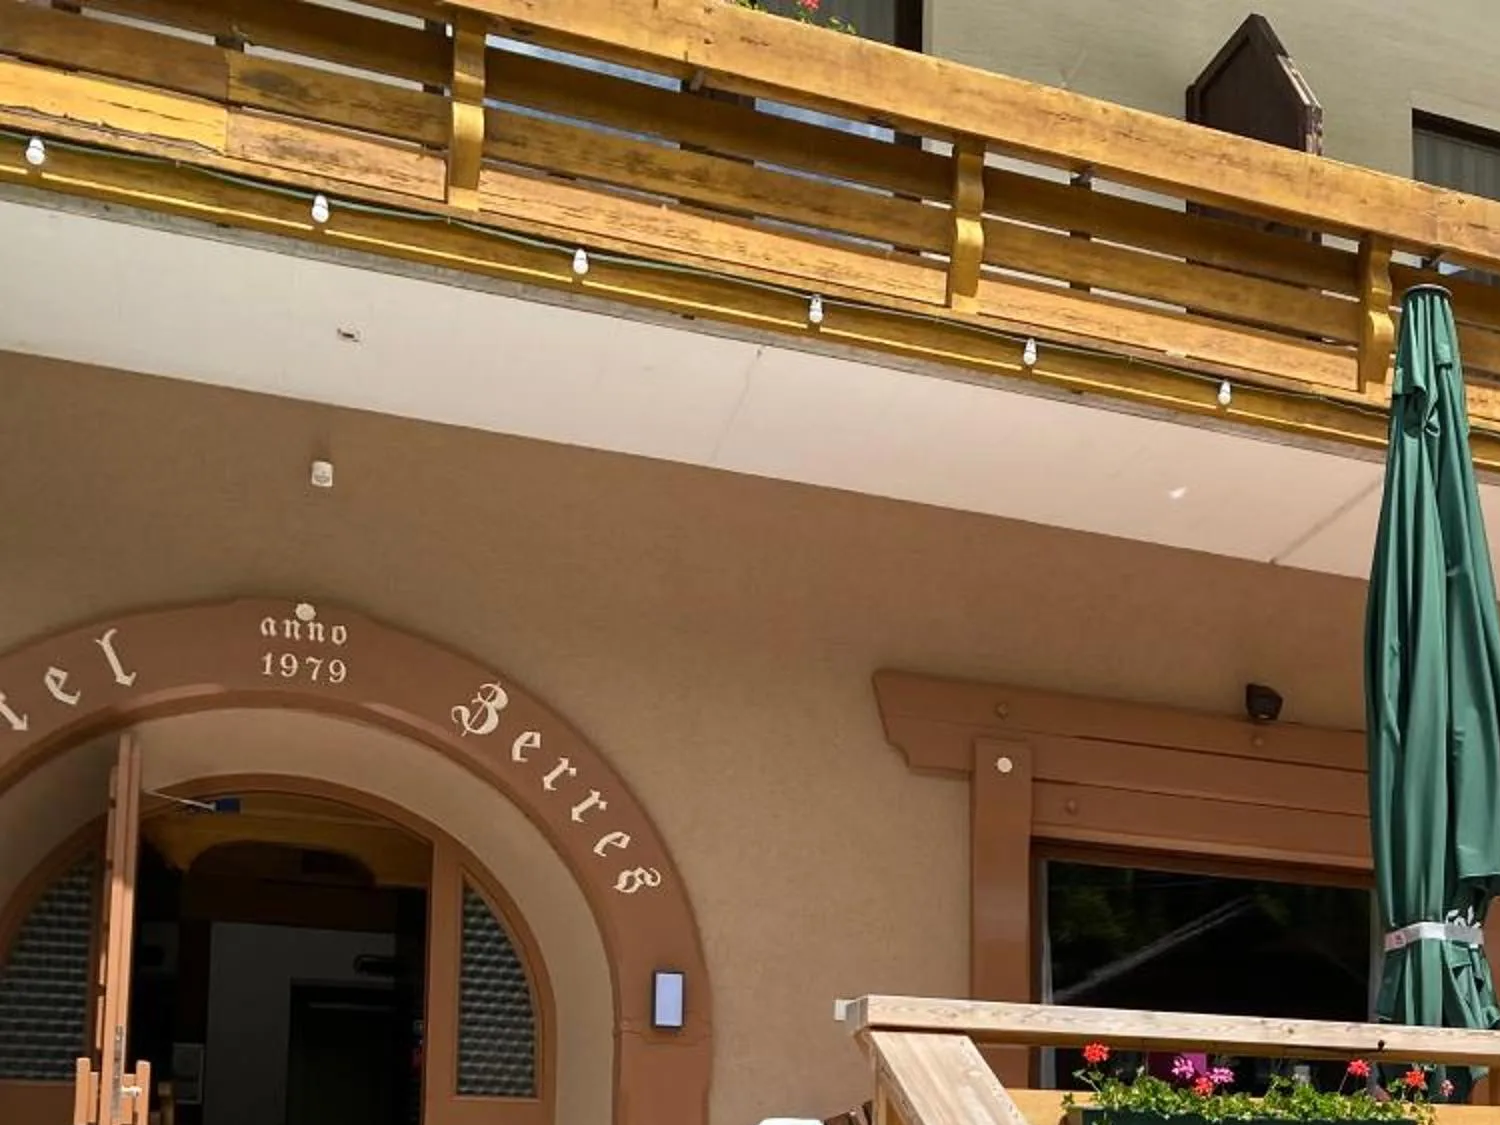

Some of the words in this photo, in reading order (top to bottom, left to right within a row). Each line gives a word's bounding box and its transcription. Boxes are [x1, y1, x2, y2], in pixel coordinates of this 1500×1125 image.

[260, 616, 347, 645] anno
[261, 652, 347, 683] 1979
[451, 681, 661, 893] Berres
